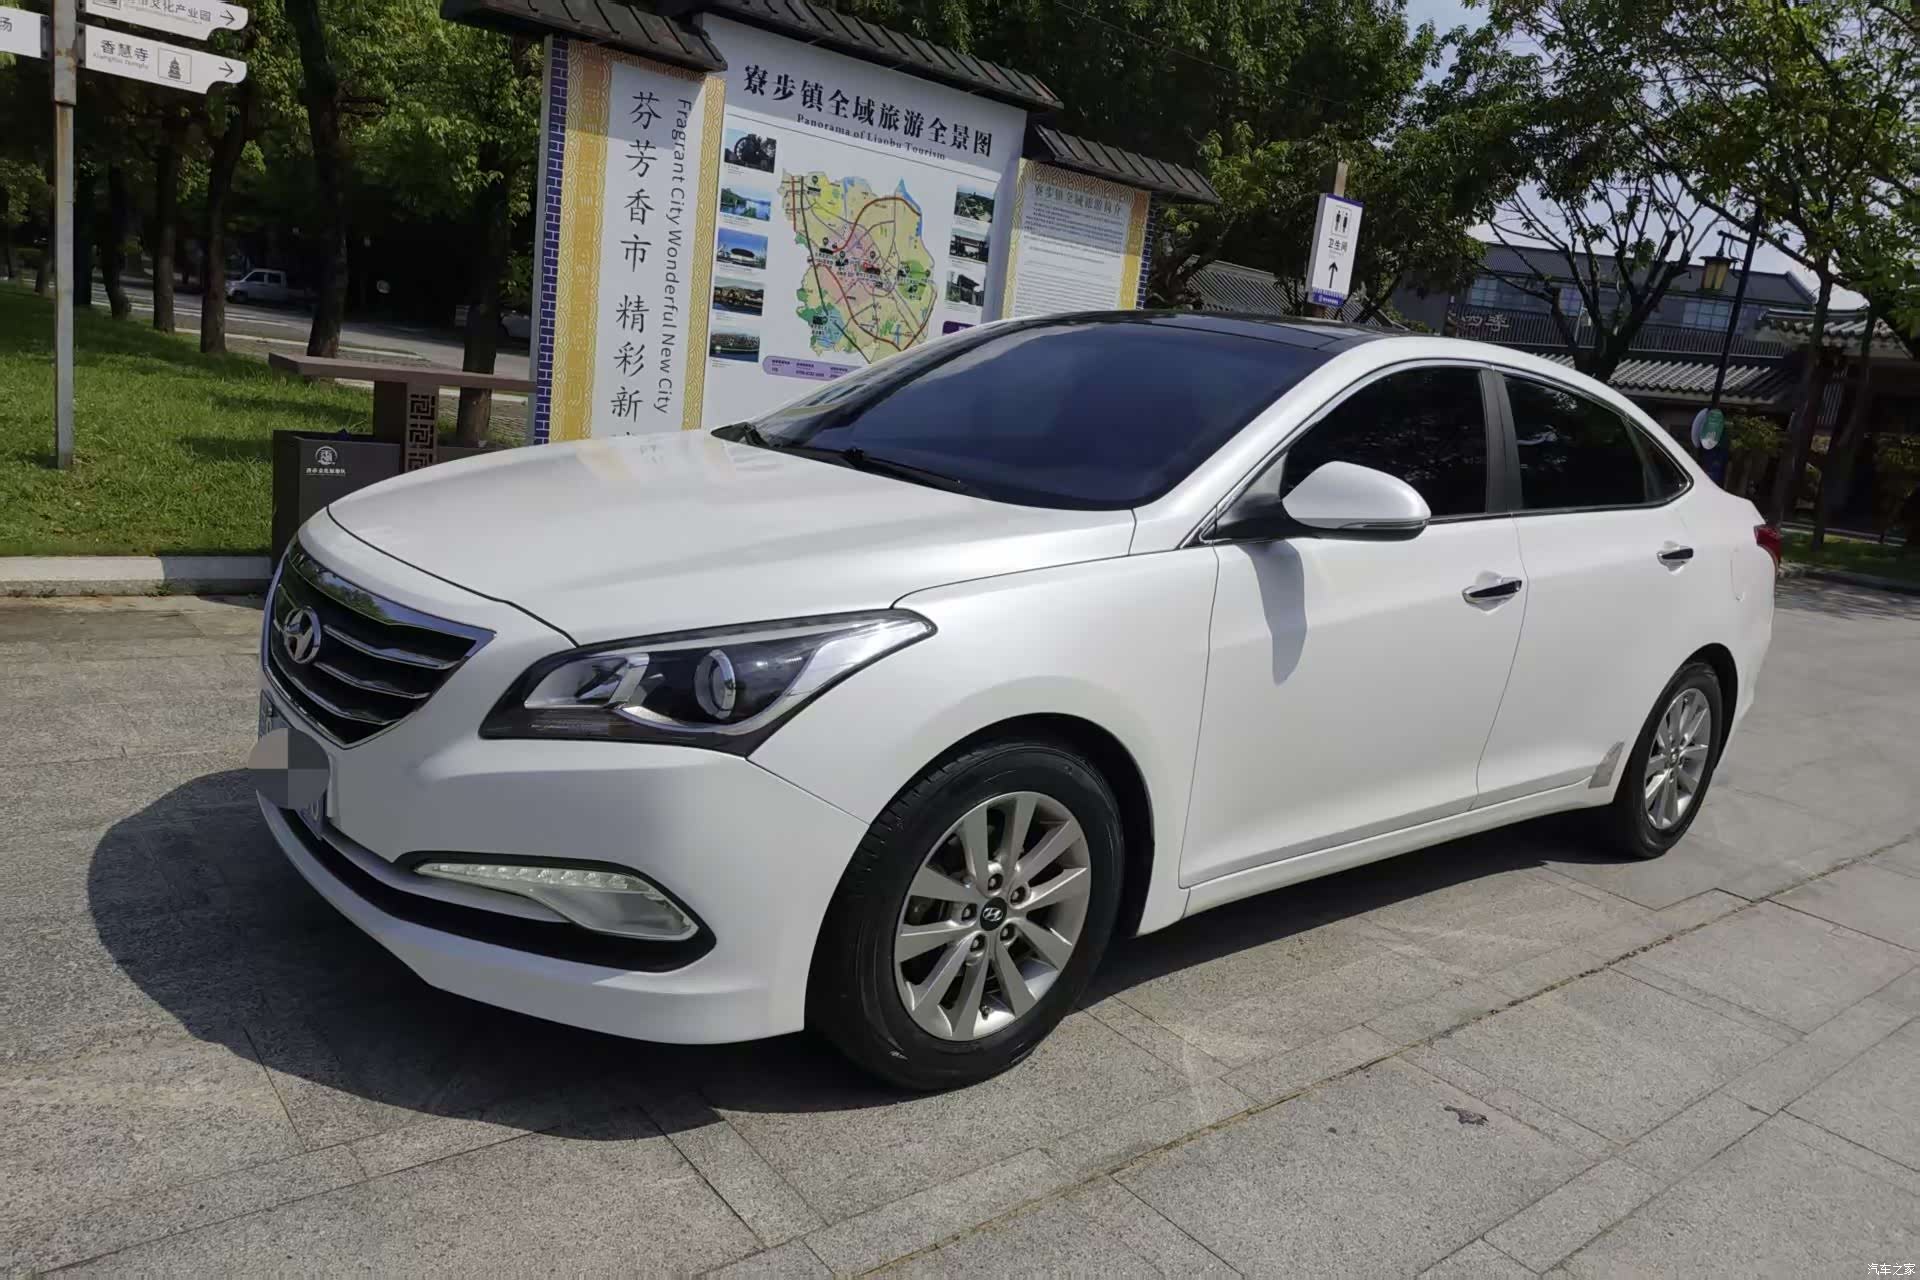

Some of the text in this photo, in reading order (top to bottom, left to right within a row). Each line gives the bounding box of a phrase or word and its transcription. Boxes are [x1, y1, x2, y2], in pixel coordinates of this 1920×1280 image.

[101, 40, 149, 61] 香慧寺
[743, 64, 993, 157] 寮步镇全域旅游全景图
[797, 113, 945, 160] Panorama of Liaobu Tourism
[610, 91, 663, 436] 芬芳香市 精彩新
[653, 98, 692, 414] Fragrant City Wonderful New City
